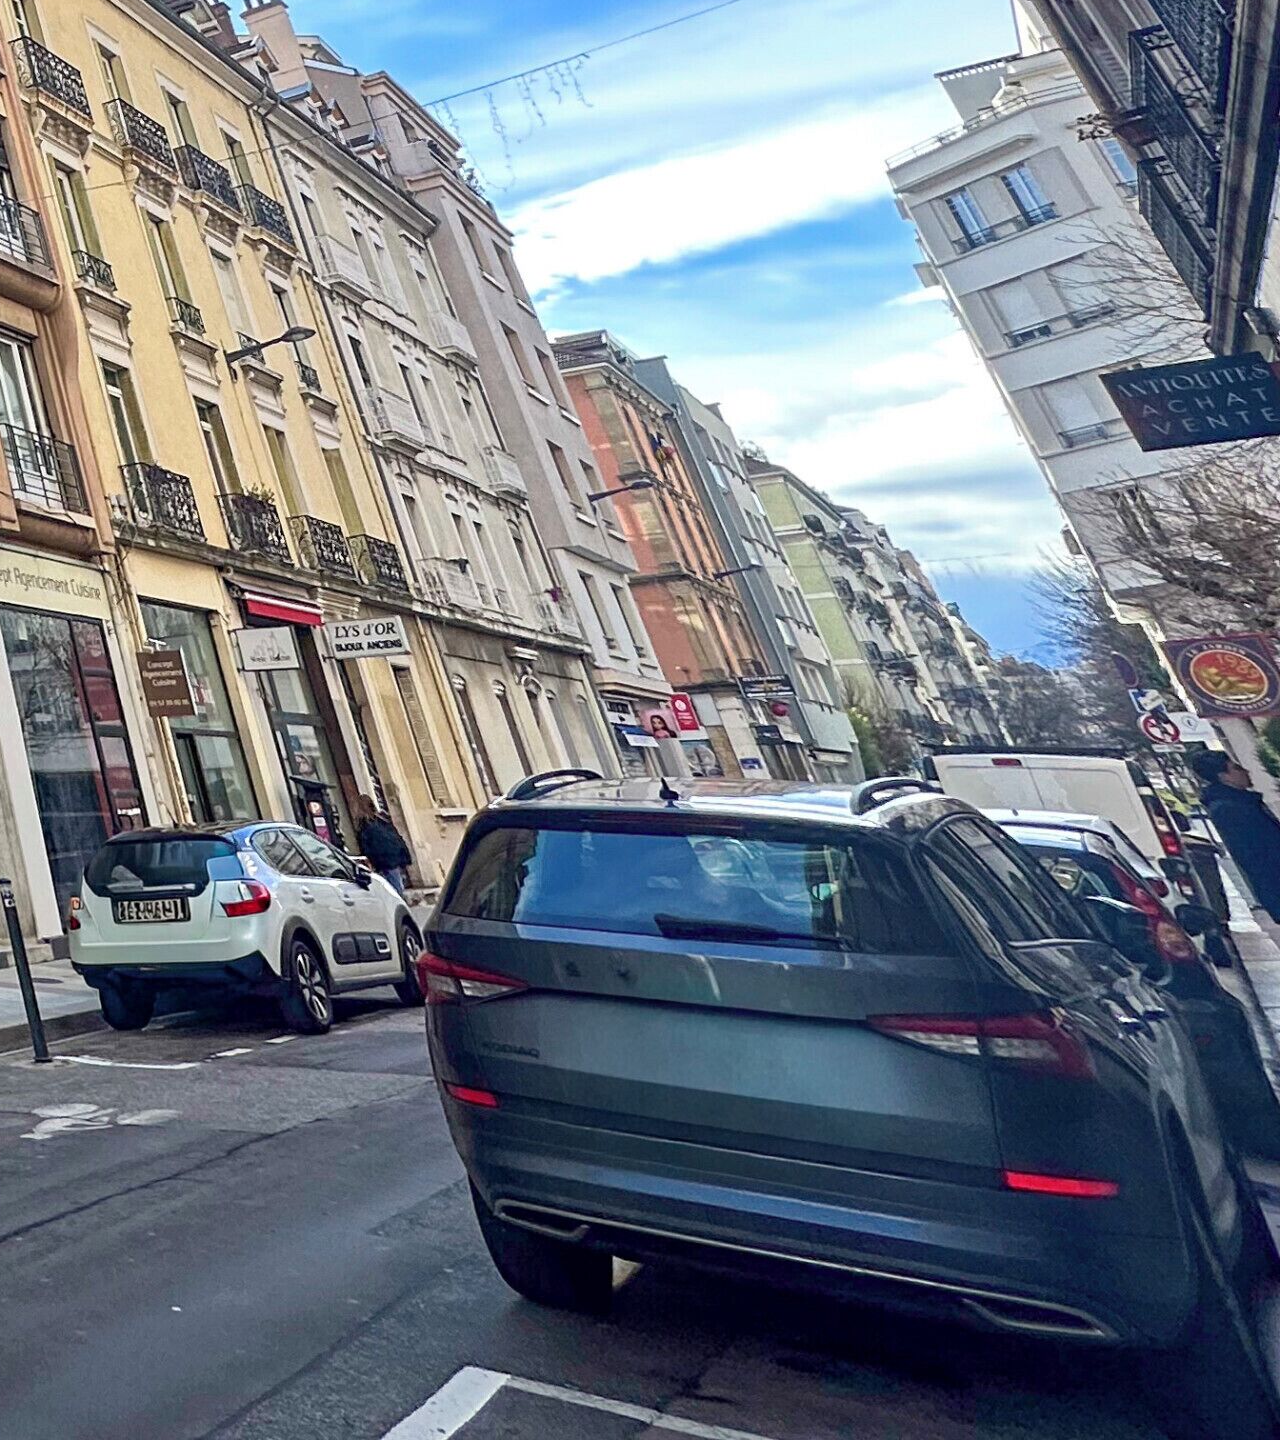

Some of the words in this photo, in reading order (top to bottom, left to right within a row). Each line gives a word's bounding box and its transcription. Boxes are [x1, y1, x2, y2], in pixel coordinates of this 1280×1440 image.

[1142, 387, 1268, 418] ACHAT
[1152, 407, 1280, 436] VENTE
[13, 567, 70, 595] Agencement
[69, 578, 102, 601] Cuisine
[335, 625, 360, 639] LYS
[363, 622, 397, 637] d'OR
[335, 642, 364, 653] BIJOUX
[367, 638, 403, 650] ANCIENS
